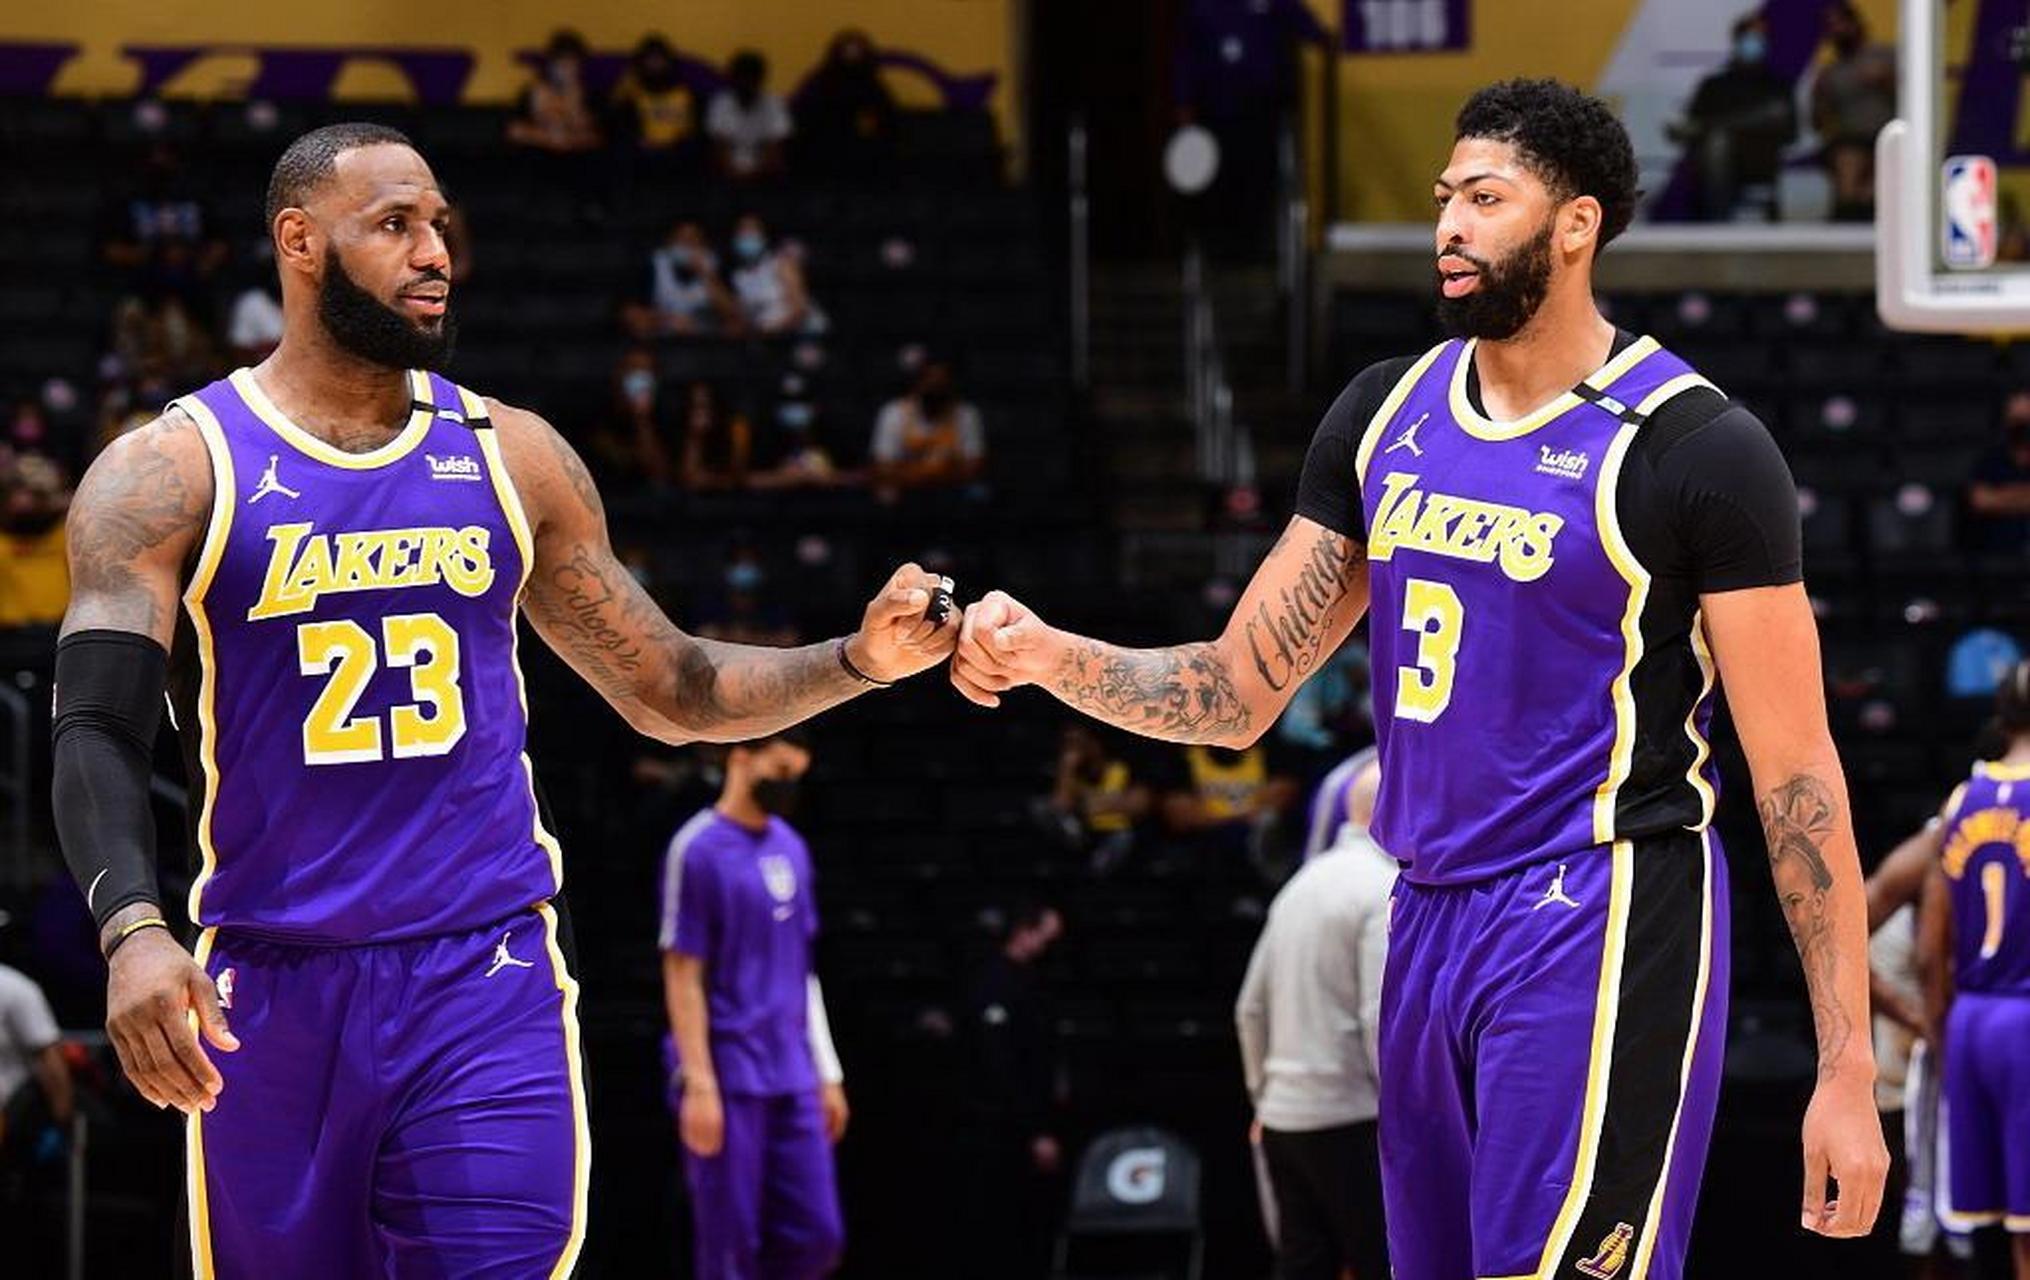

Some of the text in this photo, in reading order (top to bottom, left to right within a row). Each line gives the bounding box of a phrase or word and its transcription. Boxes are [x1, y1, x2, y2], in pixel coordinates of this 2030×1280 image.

[248, 521, 495, 621] LAKERS
[1367, 471, 1565, 582] LAKERS
[297, 612, 467, 765] 23
[1394, 578, 1464, 724] 3
[1980, 860, 2006, 960] 1
[1106, 1148, 1166, 1204] G
